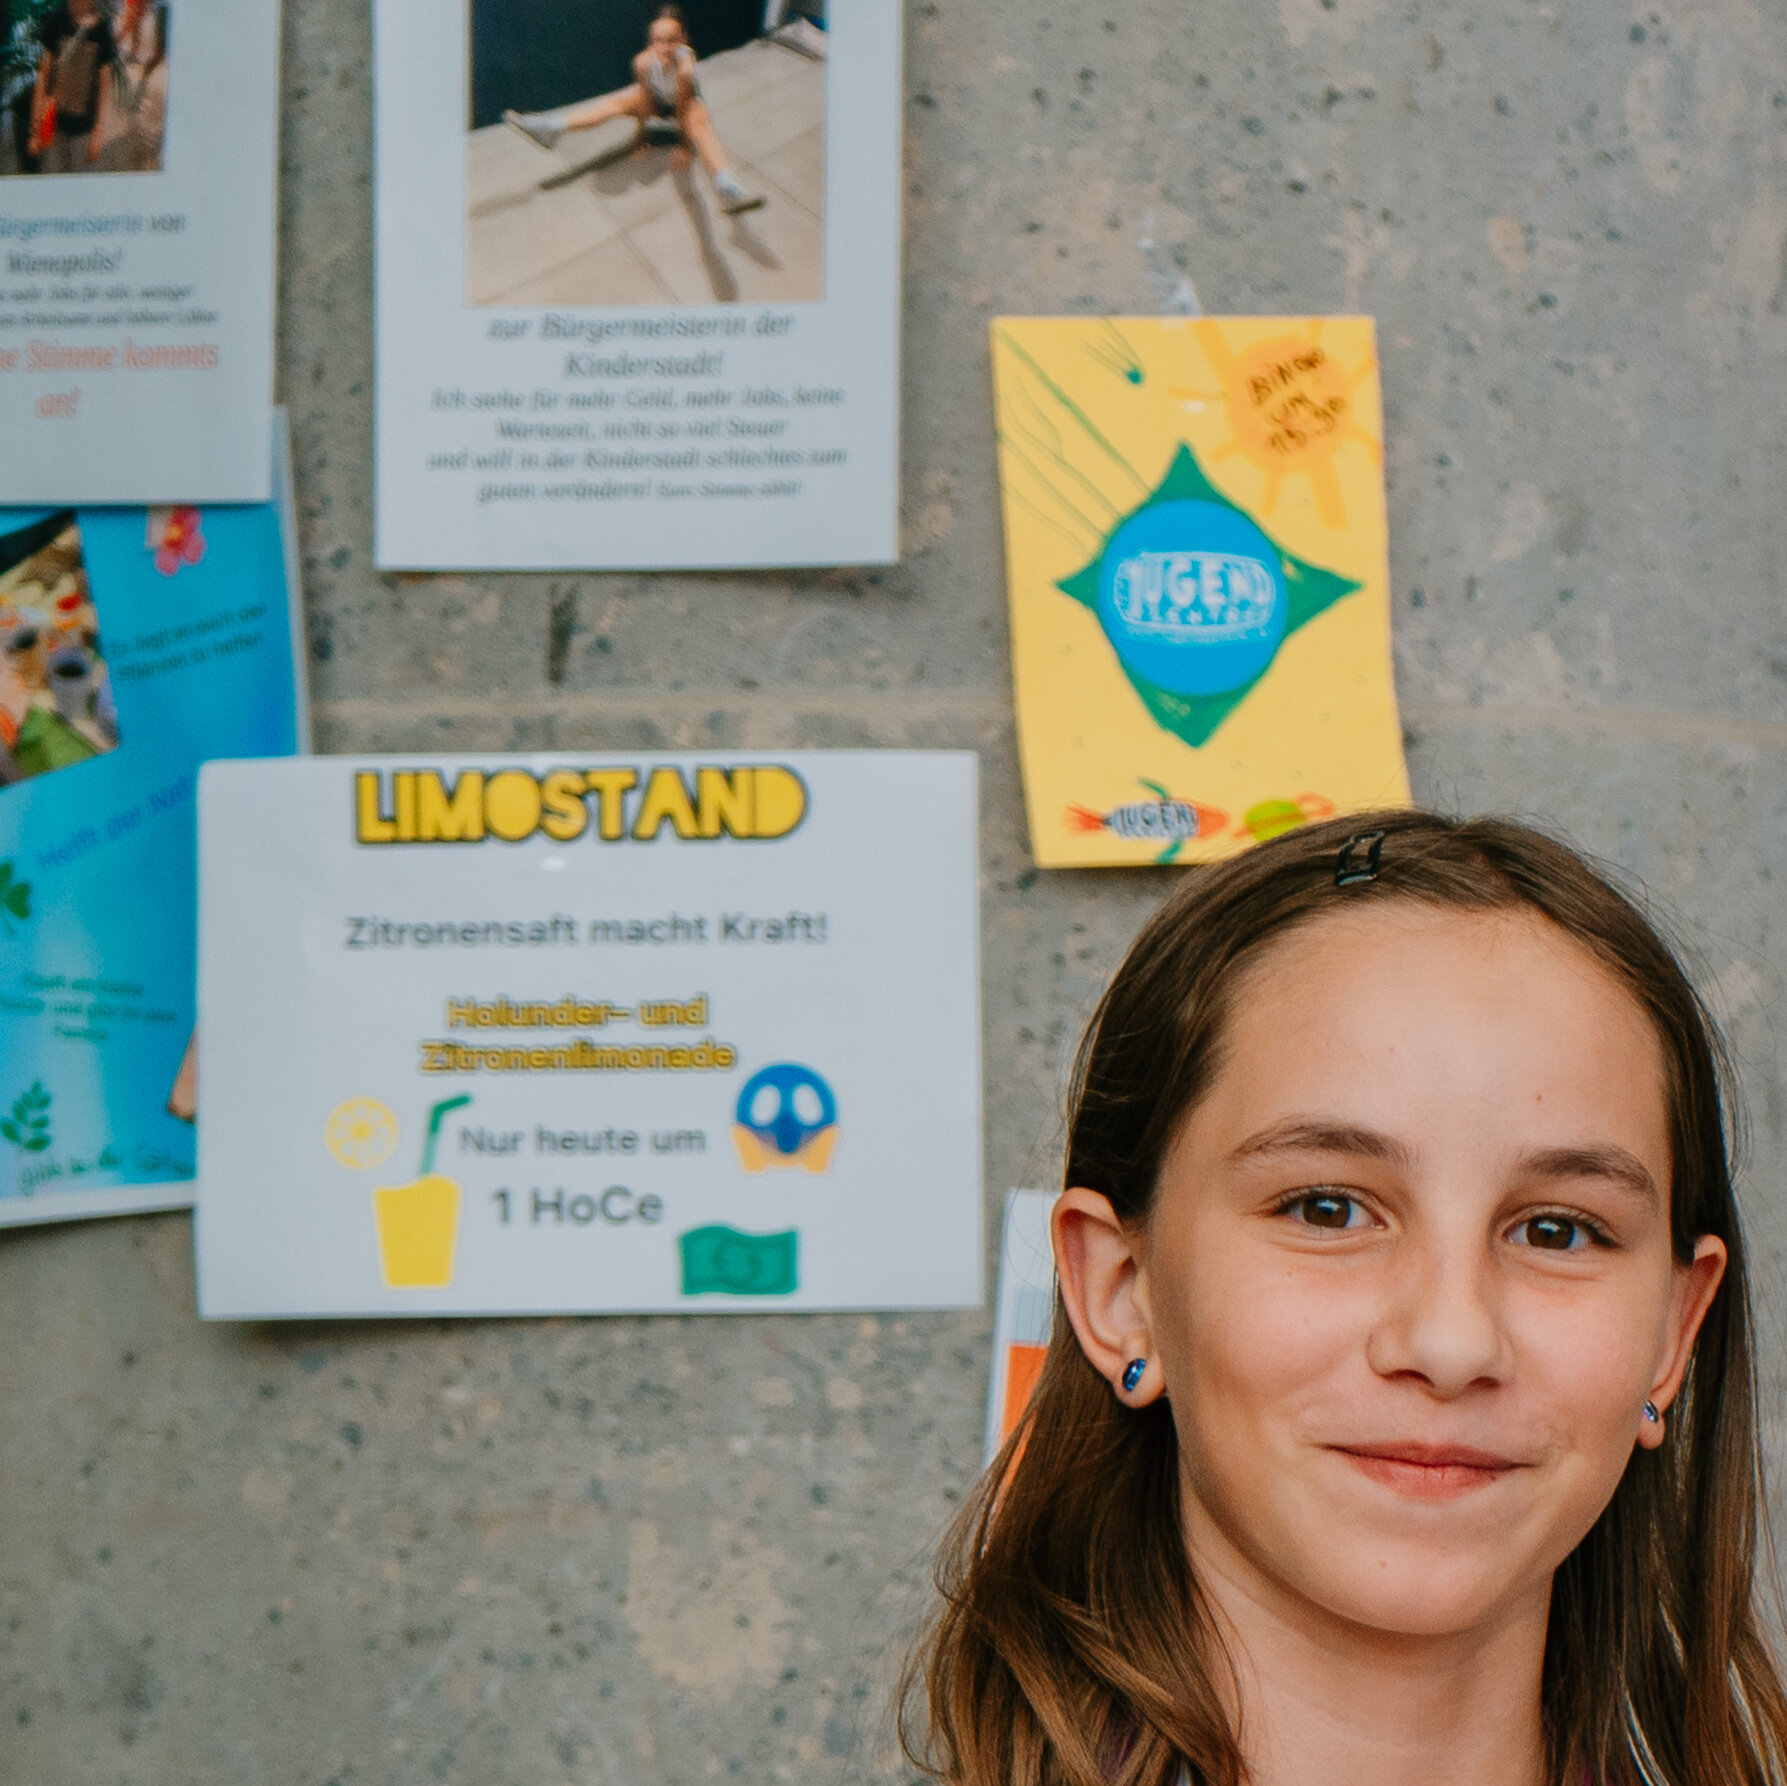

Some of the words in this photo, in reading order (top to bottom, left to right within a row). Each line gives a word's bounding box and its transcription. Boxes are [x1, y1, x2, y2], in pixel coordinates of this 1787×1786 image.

[487, 318, 532, 339] zur
[539, 311, 747, 344] Bürgermeisterin
[753, 309, 795, 337] der
[25, 338, 116, 372] Stimme
[563, 350, 725, 378] Kinderstadt!
[432, 386, 466, 411] Ich
[529, 386, 559, 413] für
[567, 388, 615, 410] mehr
[684, 385, 735, 407] mehr
[427, 446, 469, 469] und
[583, 448, 700, 470] Kinderstadt
[148, 774, 196, 813] Nat
[354, 763, 810, 846] LIMOSTAND
[344, 913, 578, 950] Zitronensaft
[589, 911, 708, 946] macht
[718, 909, 829, 945] Kraft!
[446, 994, 632, 1030] Holunder-
[638, 990, 709, 1028] und
[418, 1036, 738, 1076] Zitronenlimonade
[458, 1124, 522, 1155] Nur
[534, 1122, 638, 1156] heute
[650, 1126, 707, 1154] um
[489, 1186, 512, 1225] 1
[528, 1183, 665, 1226] HoCe
